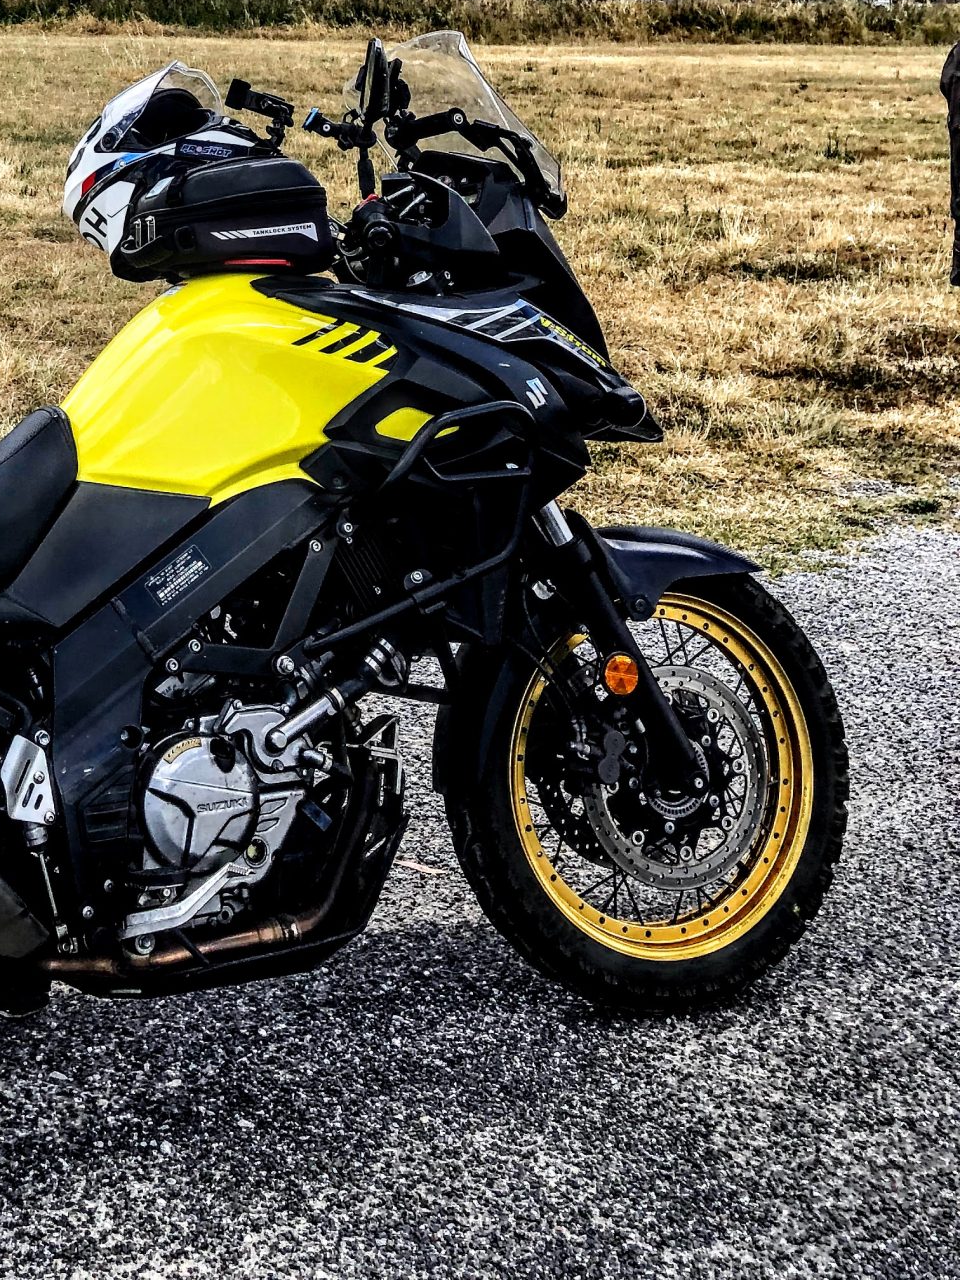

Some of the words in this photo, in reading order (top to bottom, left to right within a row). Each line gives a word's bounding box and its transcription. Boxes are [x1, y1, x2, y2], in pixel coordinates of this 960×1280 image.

[252, 225, 286, 236] TANKLOCK
[287, 223, 312, 233] SYSTEM
[196, 796, 248, 814] SUZUKI
